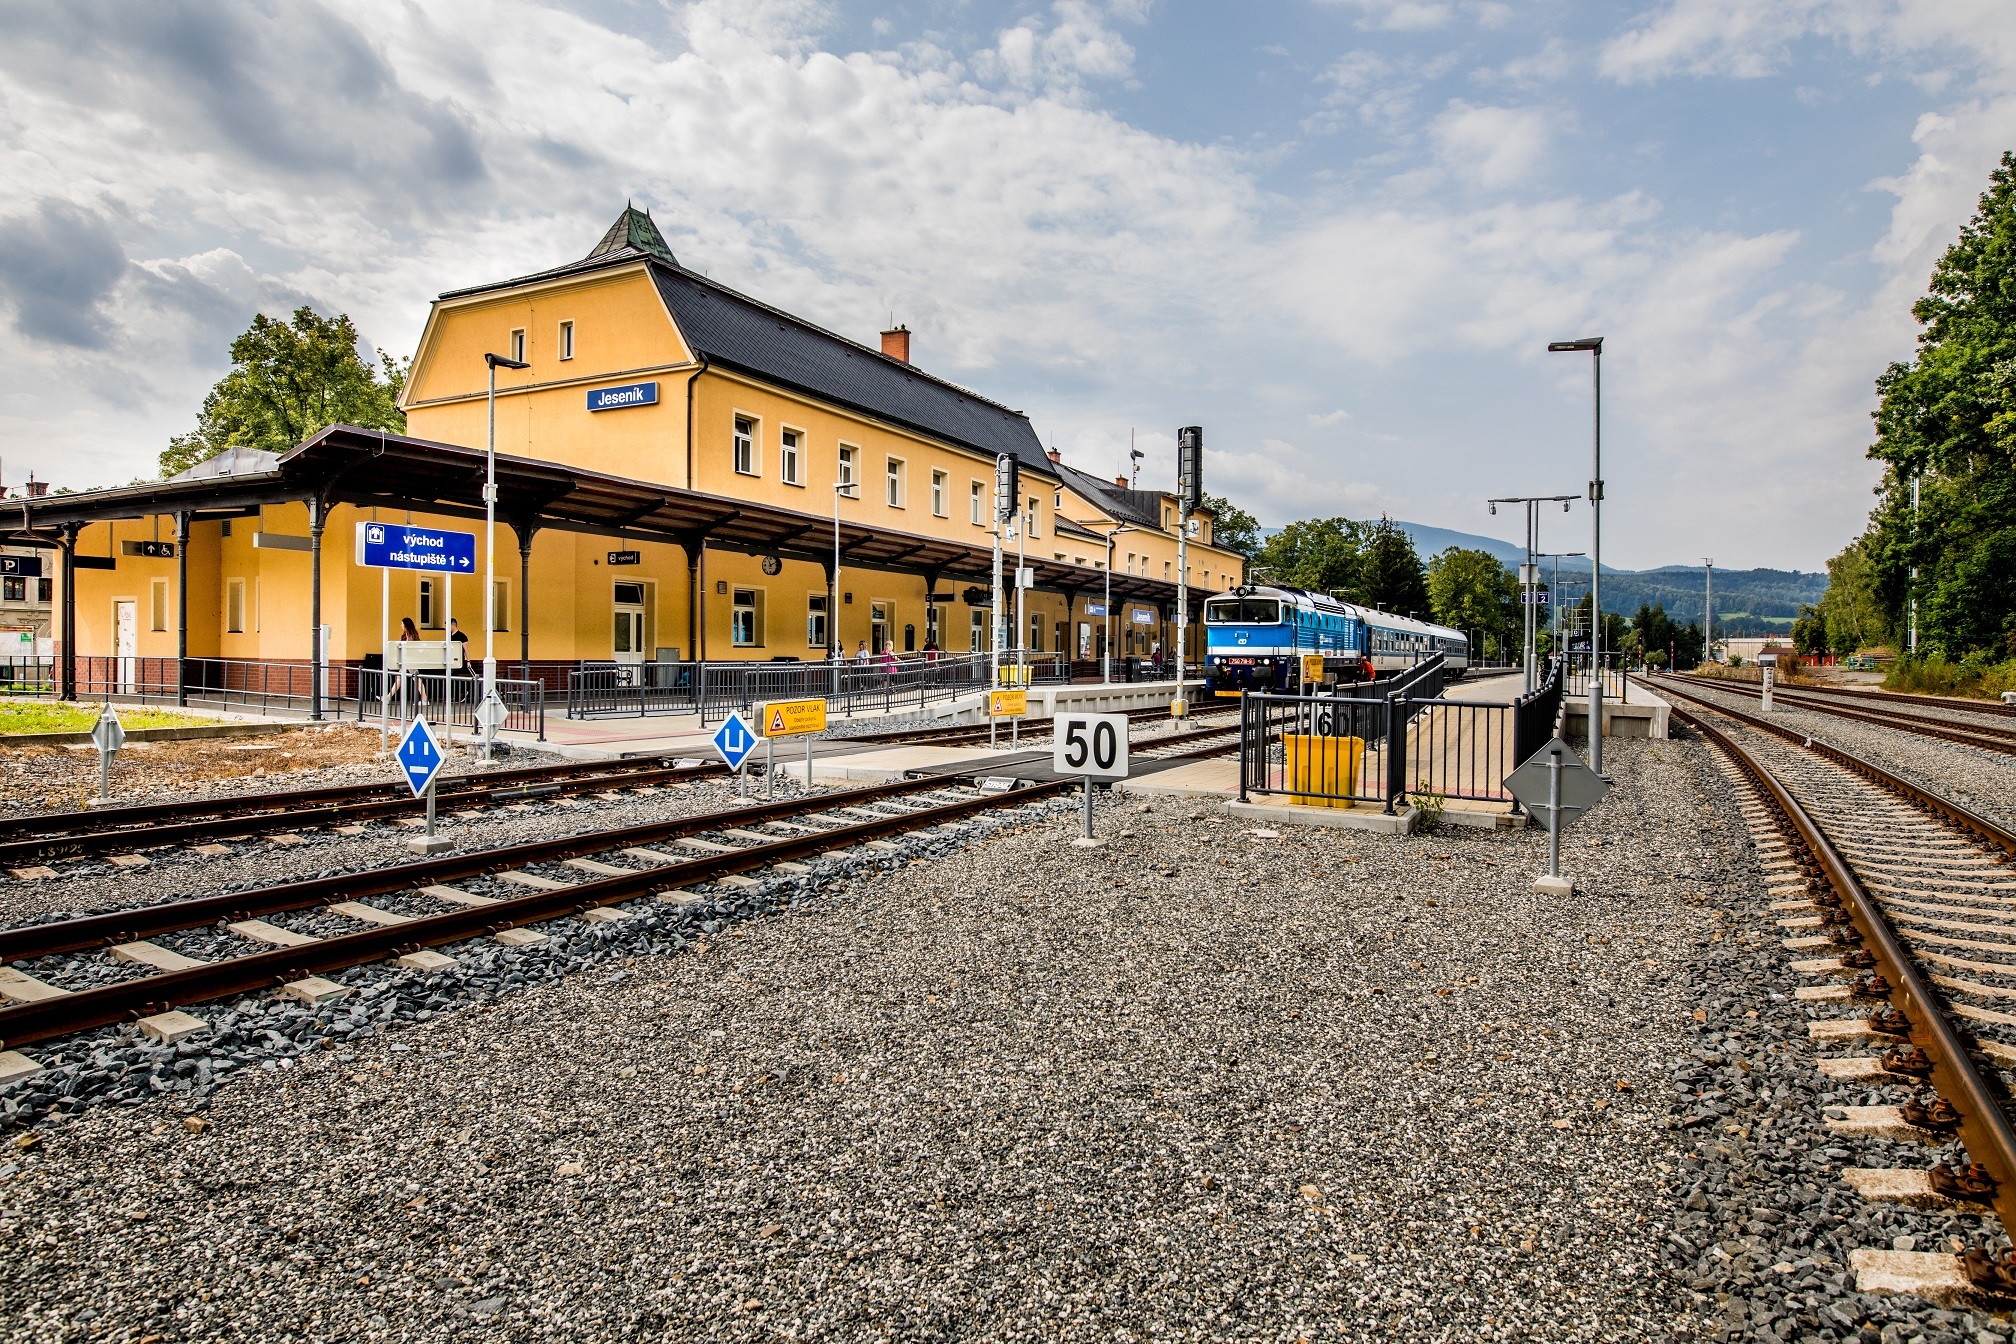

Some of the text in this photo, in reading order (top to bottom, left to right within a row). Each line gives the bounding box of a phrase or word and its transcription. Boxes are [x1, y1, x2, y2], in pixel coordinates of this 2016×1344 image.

[598, 387, 643, 405] Jeseník
[403, 534, 443, 547] východ
[390, 551, 455, 566] nástupiště 1
[786, 705, 805, 714] POZOR
[807, 703, 820, 712] VLAK
[1064, 720, 1117, 769] 50
